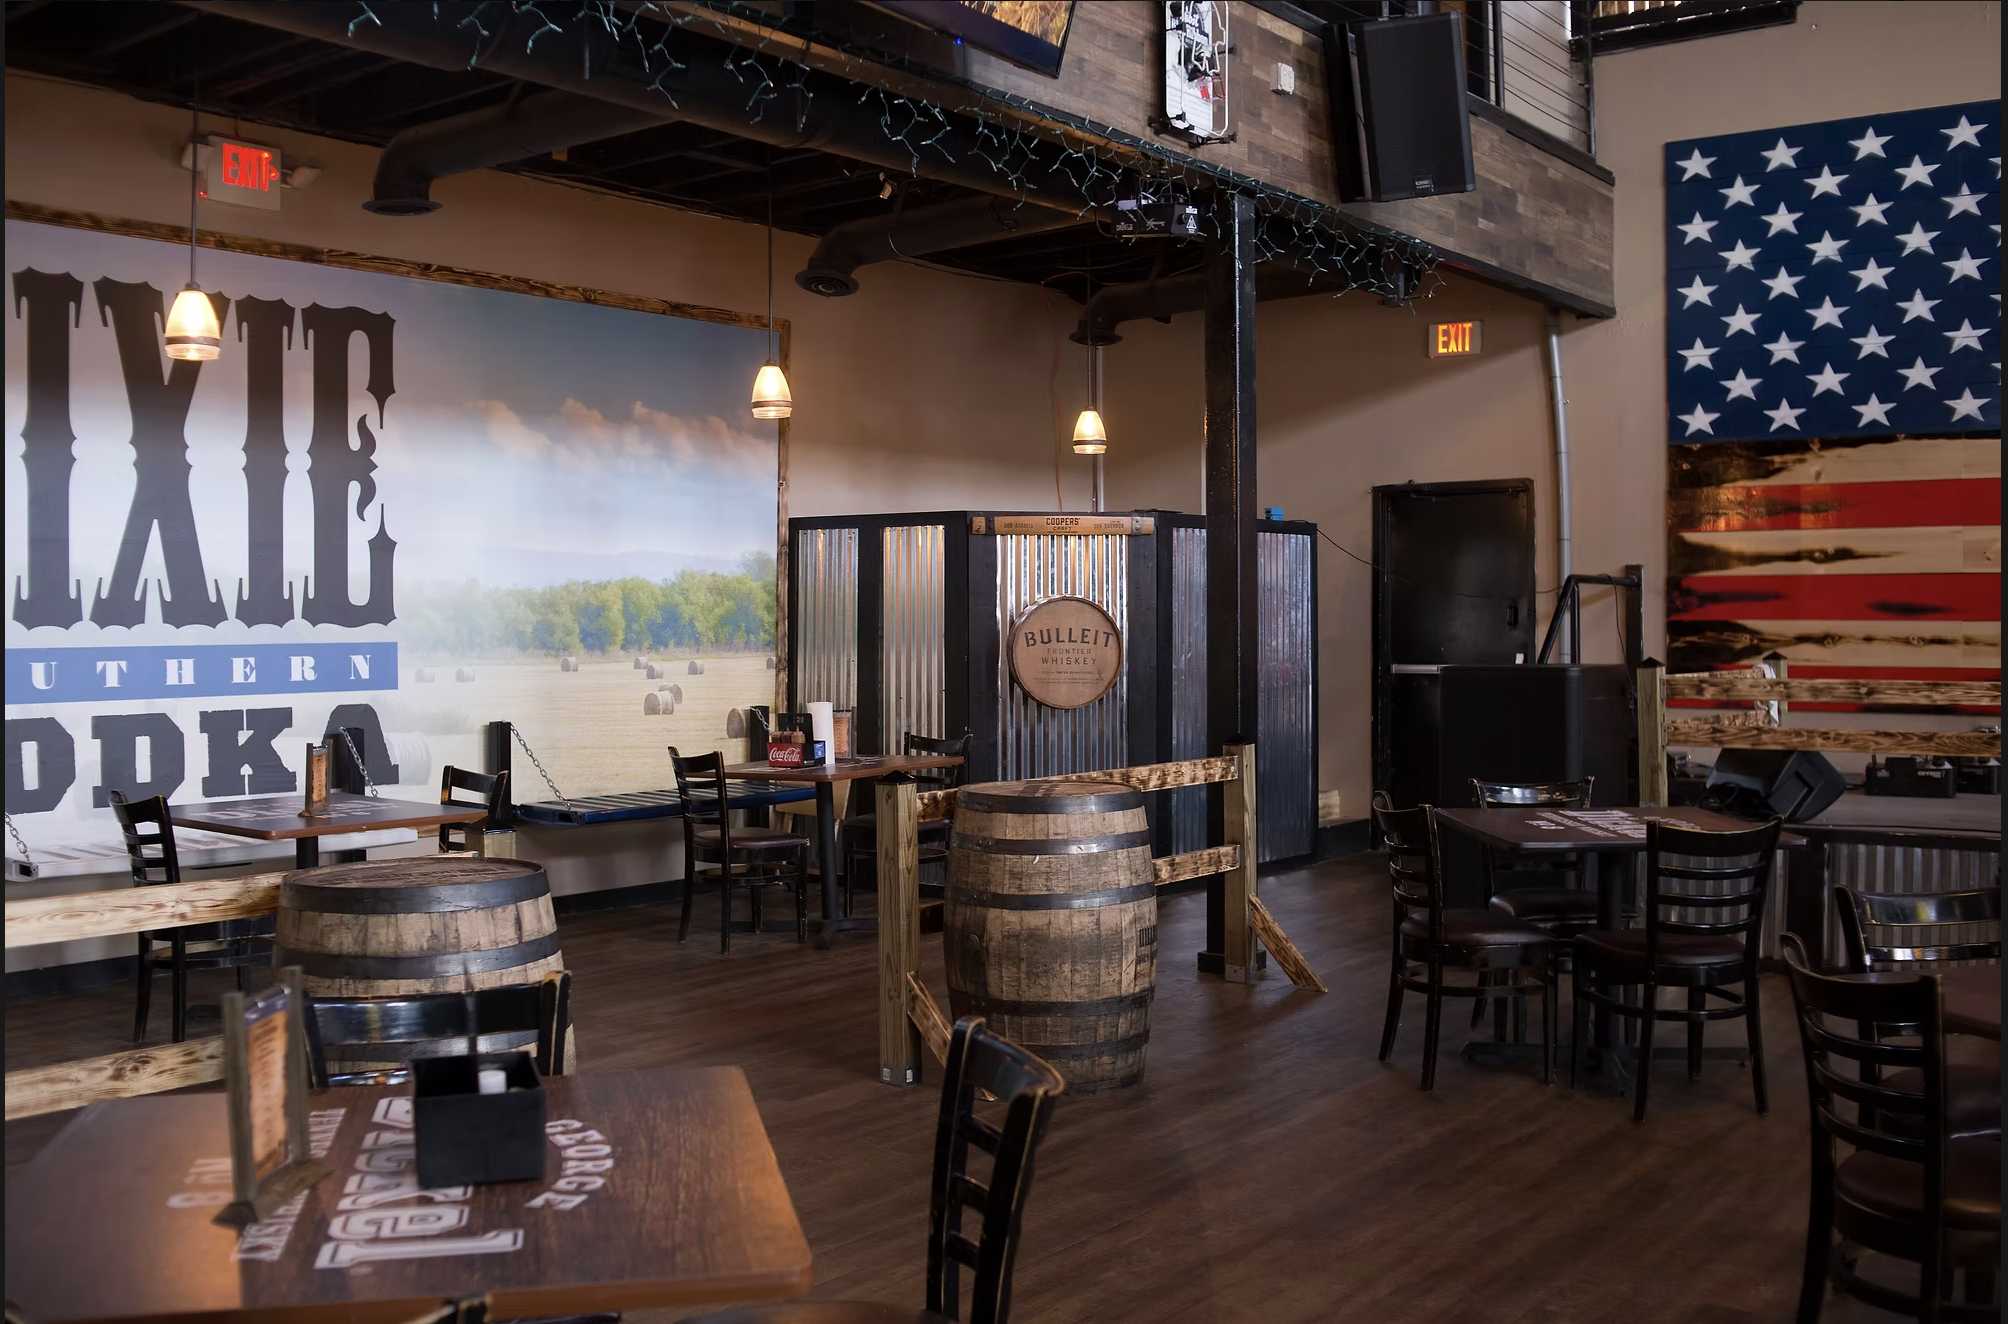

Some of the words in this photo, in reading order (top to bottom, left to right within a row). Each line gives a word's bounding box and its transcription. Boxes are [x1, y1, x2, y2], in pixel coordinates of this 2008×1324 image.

[223, 143, 273, 191] EXIT
[1437, 322, 1473, 354] EXIT
[1024, 628, 1114, 648] BULLEIT
[1041, 657, 1097, 665] WHISKEY
[523, 1119, 614, 1211] GEORGE
